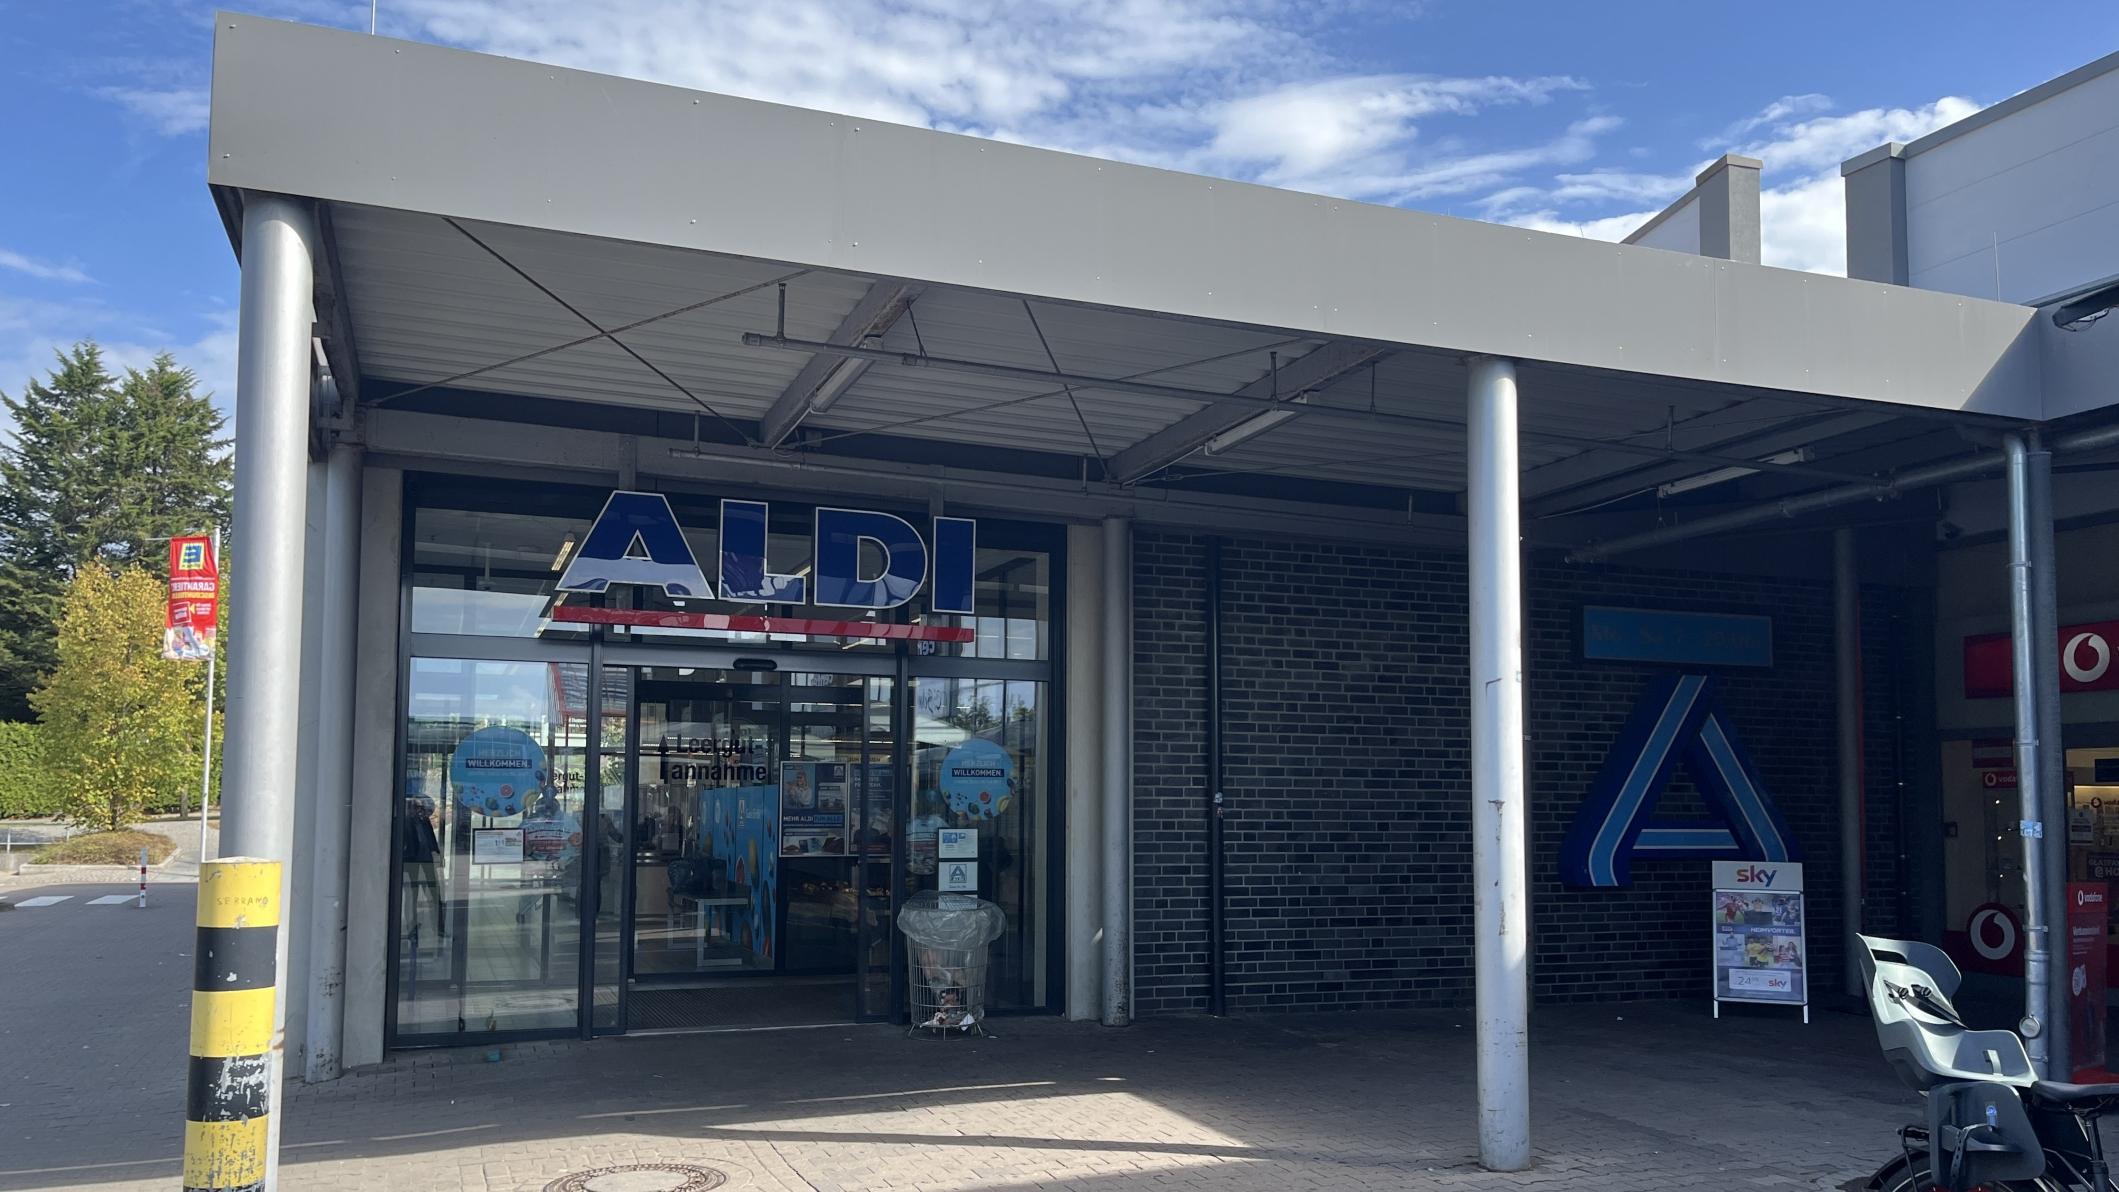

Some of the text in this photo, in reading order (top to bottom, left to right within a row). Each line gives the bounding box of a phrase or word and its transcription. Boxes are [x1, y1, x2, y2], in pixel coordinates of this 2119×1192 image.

[555, 490, 976, 616] ALDI
[671, 764, 767, 781] annahme
[1736, 865, 1777, 887] sky
[1768, 978, 1787, 989] sky
